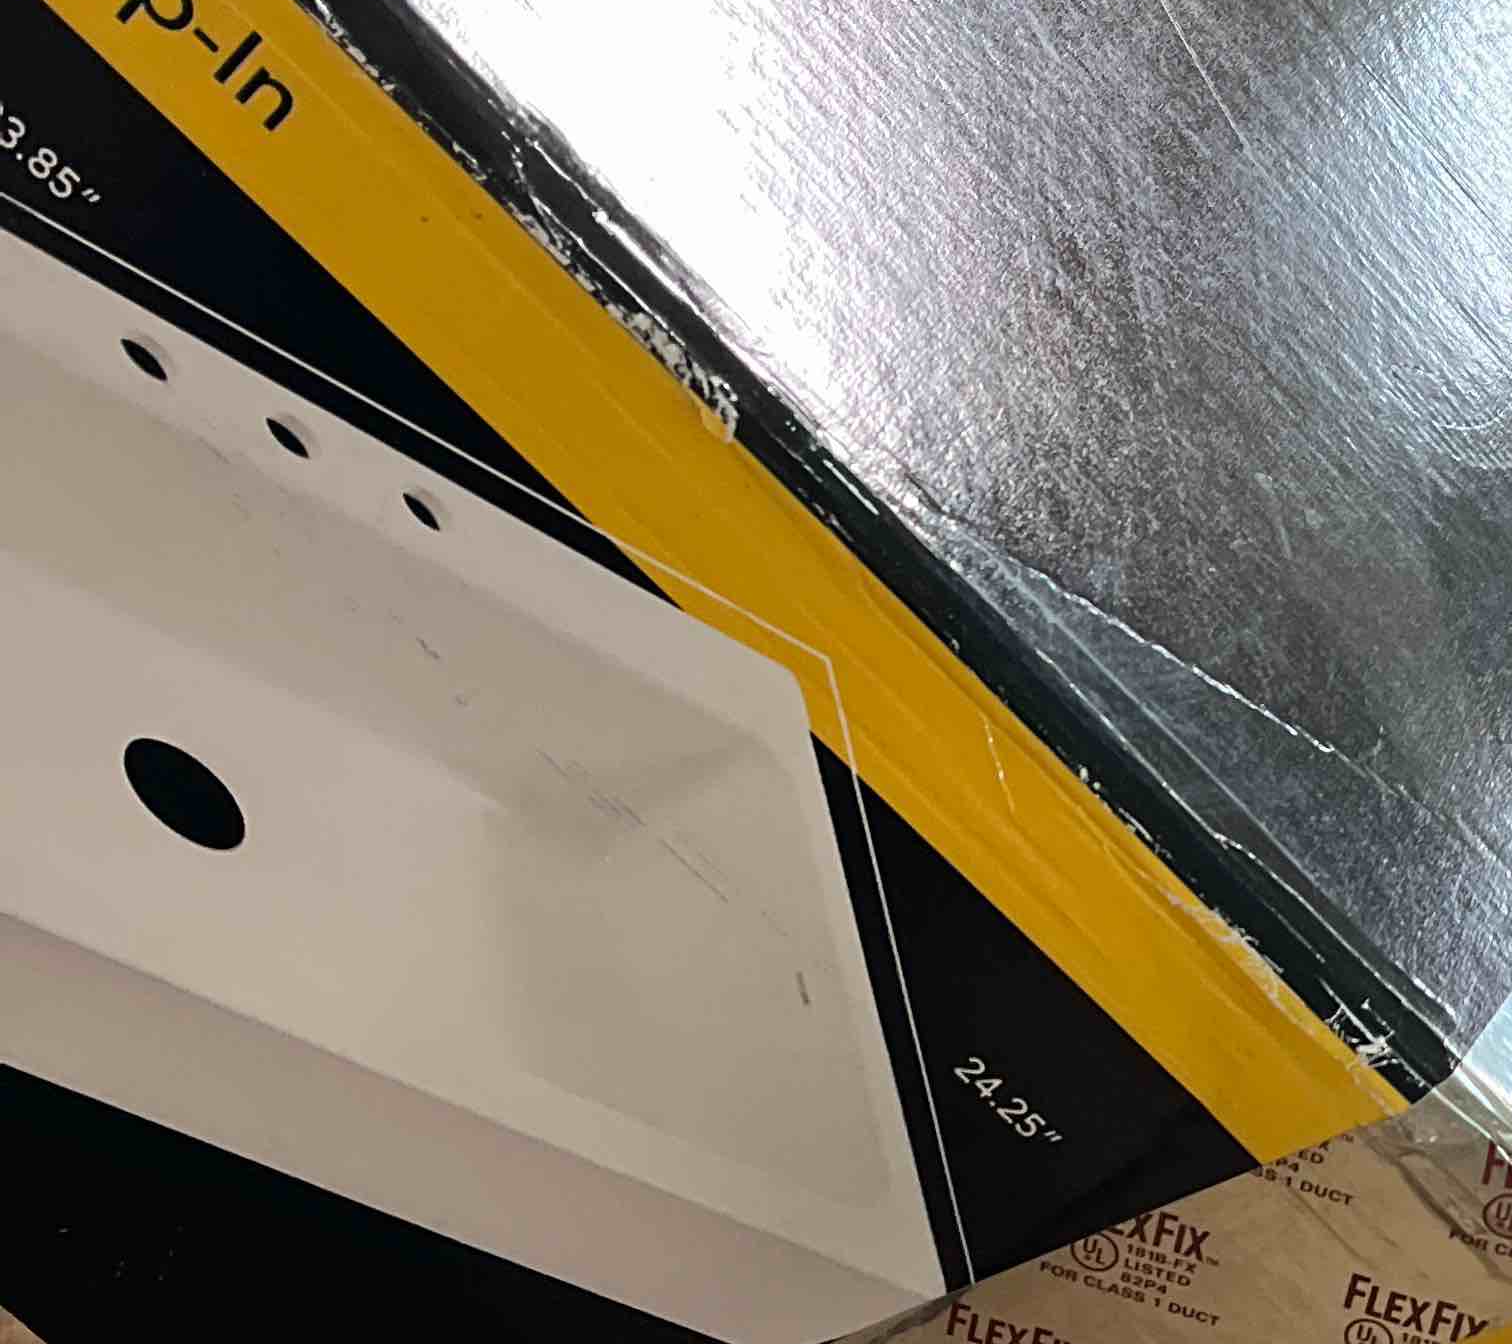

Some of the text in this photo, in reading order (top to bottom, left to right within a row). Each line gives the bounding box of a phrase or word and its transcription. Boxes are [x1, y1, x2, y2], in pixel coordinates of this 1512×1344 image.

[0, 101, 101, 203] 3.85"
[954, 1056, 1063, 1148] 24.25"
[1300, 1180, 1353, 1206] DUCT
[1038, 1260, 1078, 1283] FOR
[1083, 1276, 1146, 1304] CLASS
[1167, 1301, 1222, 1327] DUCT
[1119, 1270, 1168, 1296] 82P4
[1123, 1257, 1192, 1288] LISTED
